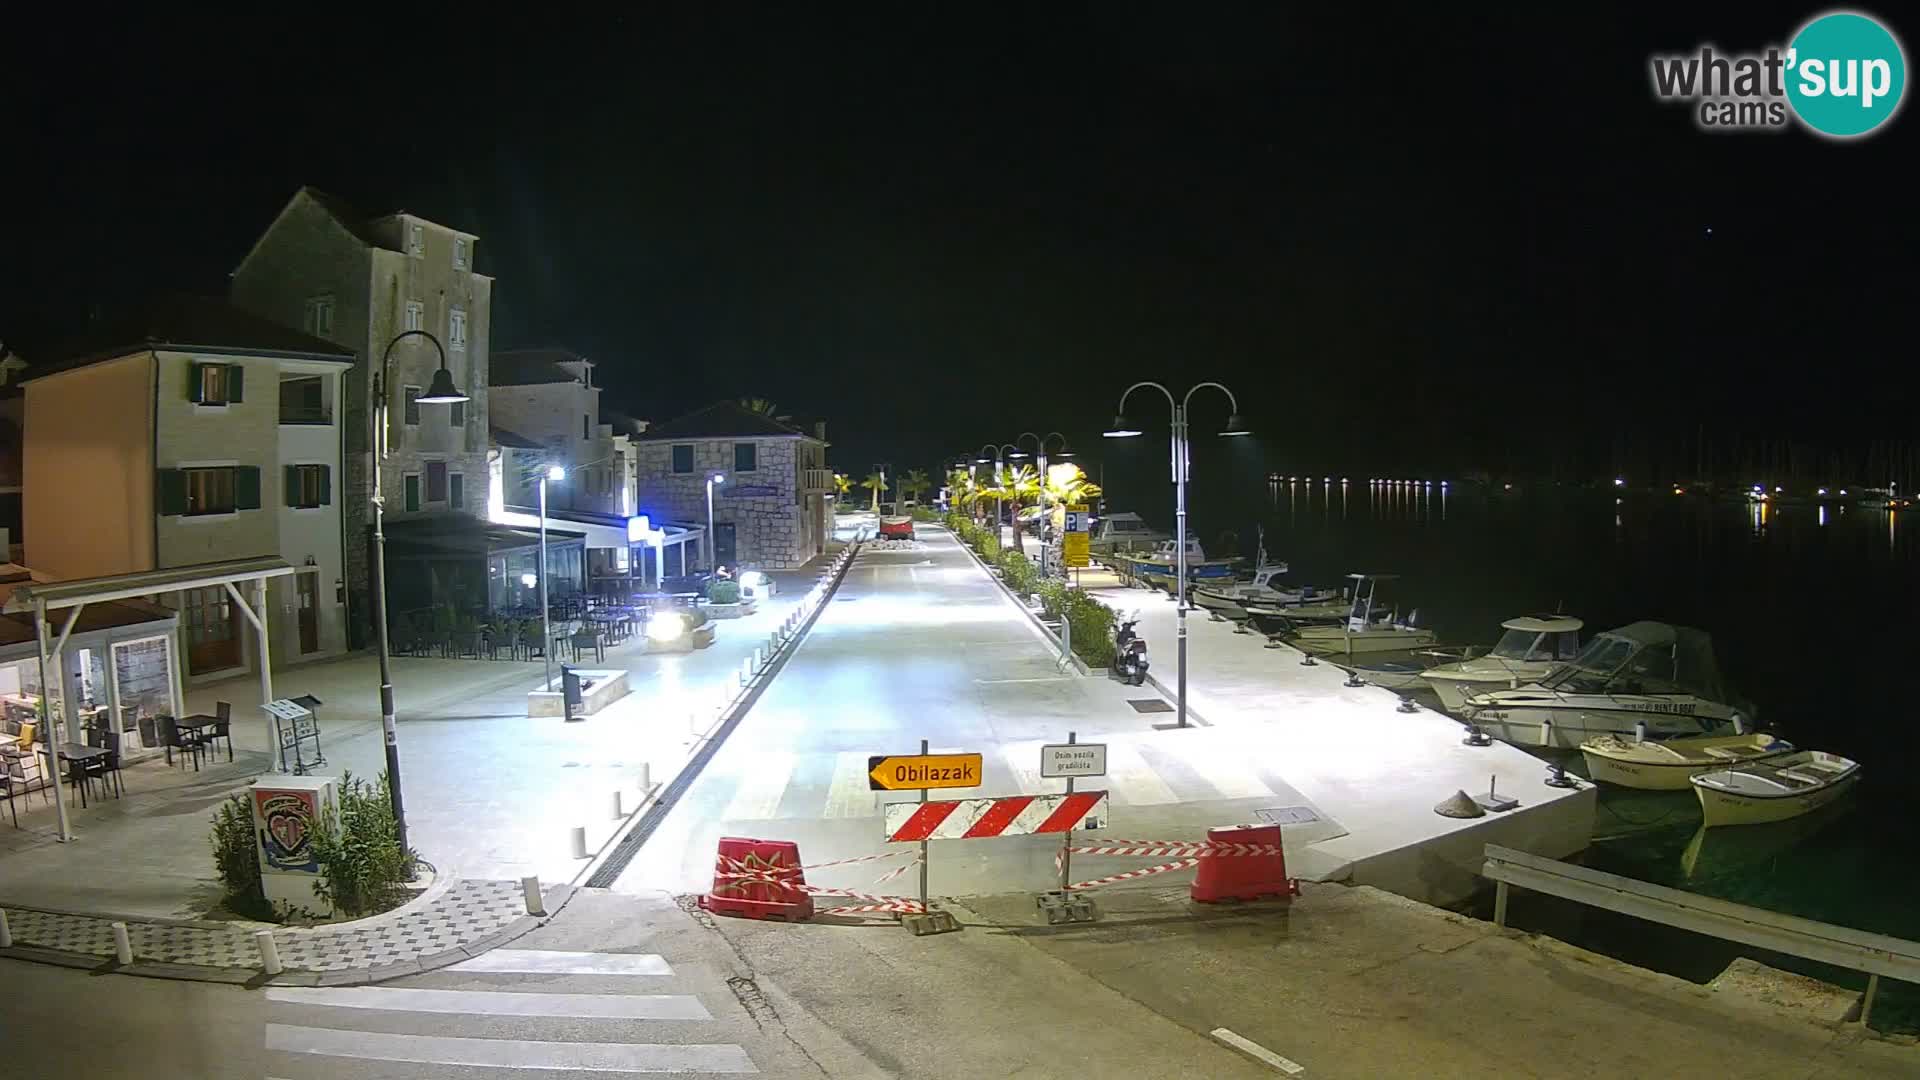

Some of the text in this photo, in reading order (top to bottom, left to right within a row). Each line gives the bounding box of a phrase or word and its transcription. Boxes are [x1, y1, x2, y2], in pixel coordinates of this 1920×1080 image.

[1066, 514, 1077, 530] P
[1654, 703, 1672, 713] RENT
[895, 763, 973, 782] Obilazak
